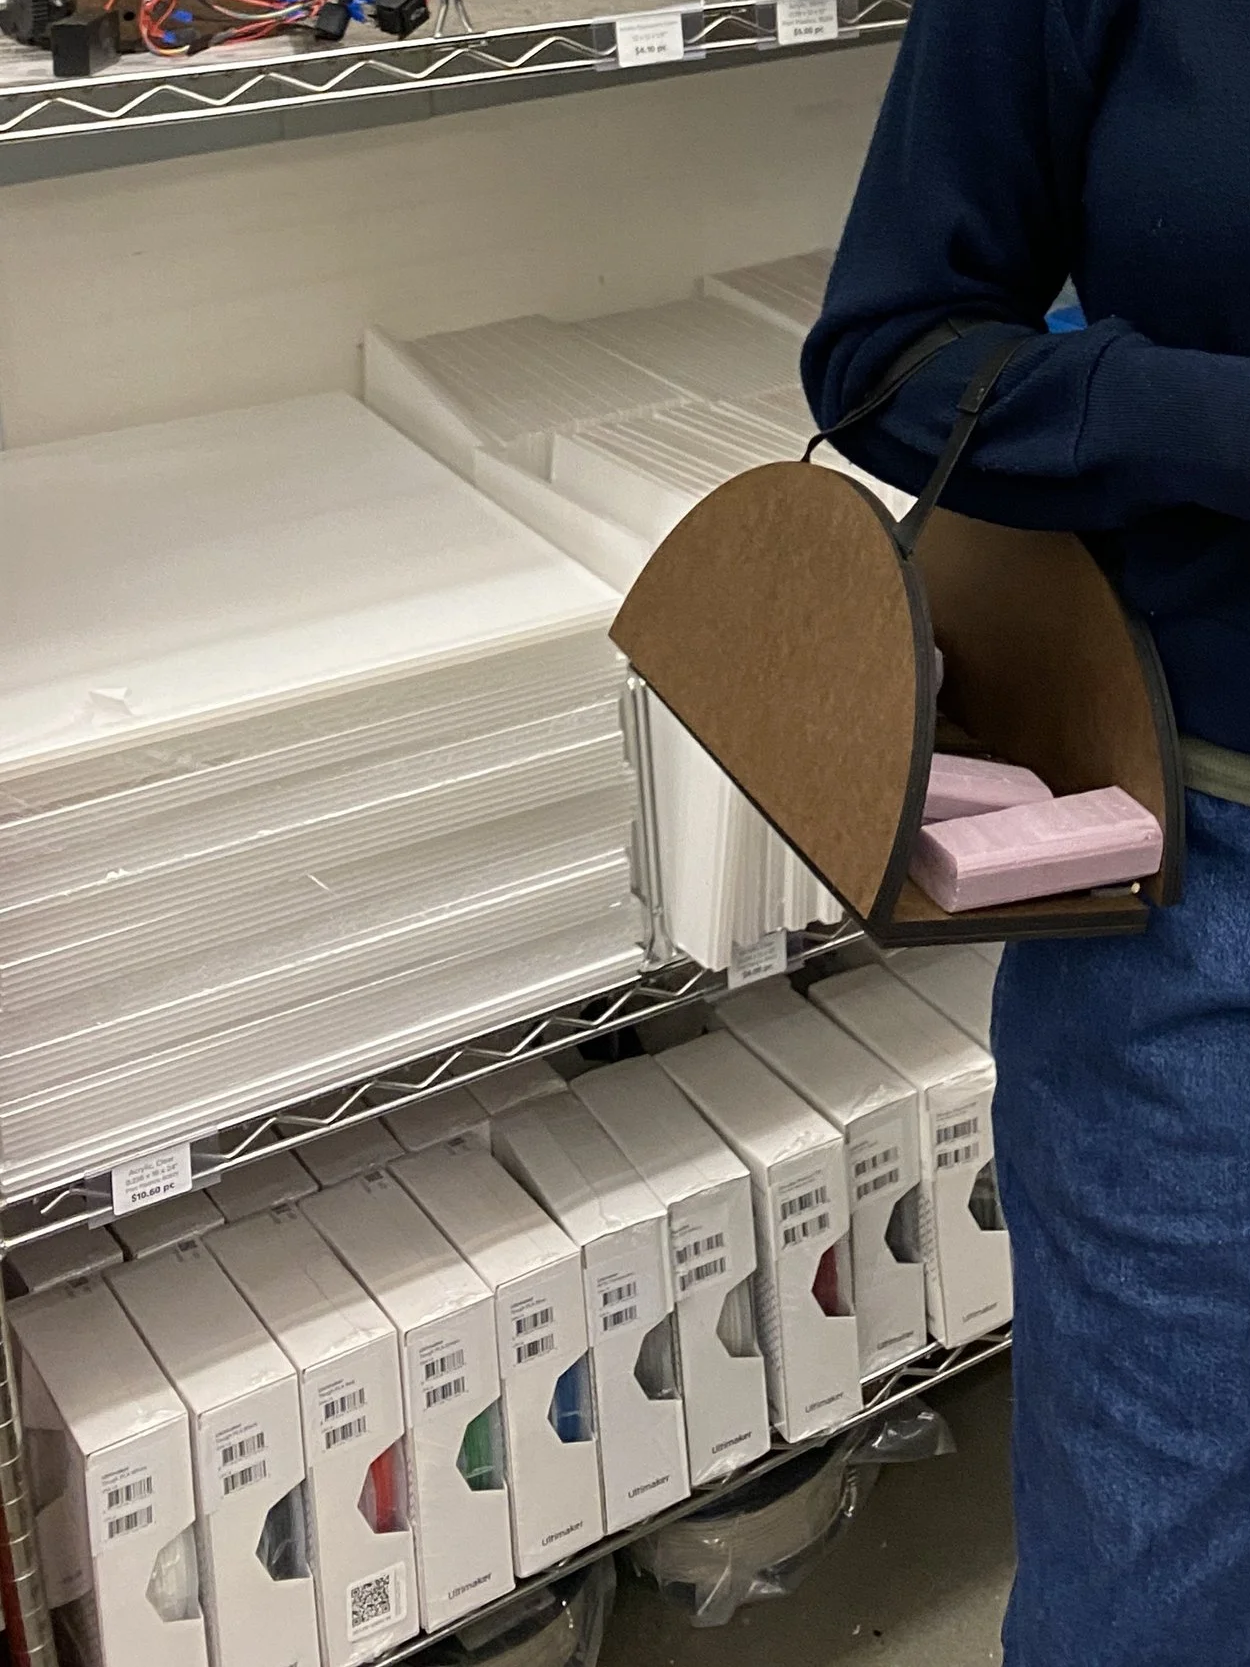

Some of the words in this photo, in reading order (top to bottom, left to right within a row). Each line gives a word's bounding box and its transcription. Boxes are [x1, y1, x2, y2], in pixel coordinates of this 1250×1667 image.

[131, 1185, 161, 1203] $10.60
[163, 1181, 176, 1193] pc
[711, 1430, 752, 1455] Ultimaker
[627, 1474, 671, 1500] Ultimaker
[541, 1519, 584, 1547] Ultimaker
[448, 1571, 493, 1601] Ultimaker
